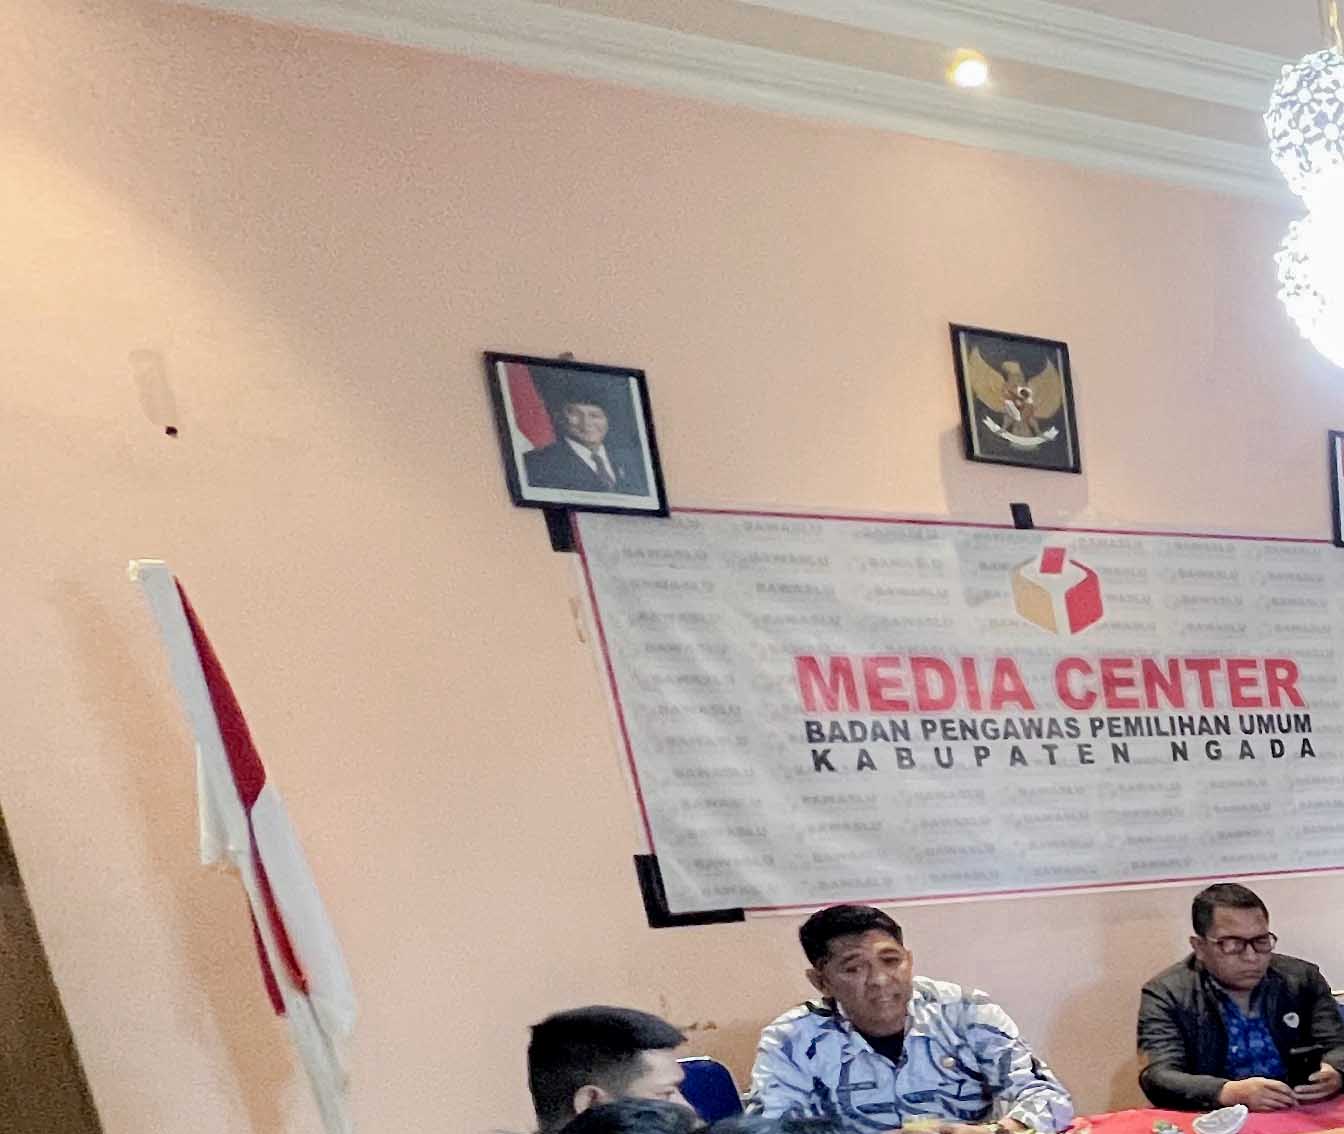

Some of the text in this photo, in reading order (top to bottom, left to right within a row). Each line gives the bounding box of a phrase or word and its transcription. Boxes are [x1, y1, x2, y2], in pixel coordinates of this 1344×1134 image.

[794, 655, 1036, 713] MEDIA
[1055, 657, 1306, 711] CENTER
[804, 713, 1313, 743] BADAN PENGAWAS PEMILIHAN UMUM
[811, 737, 1316, 772] KABUPATEN NGADA
